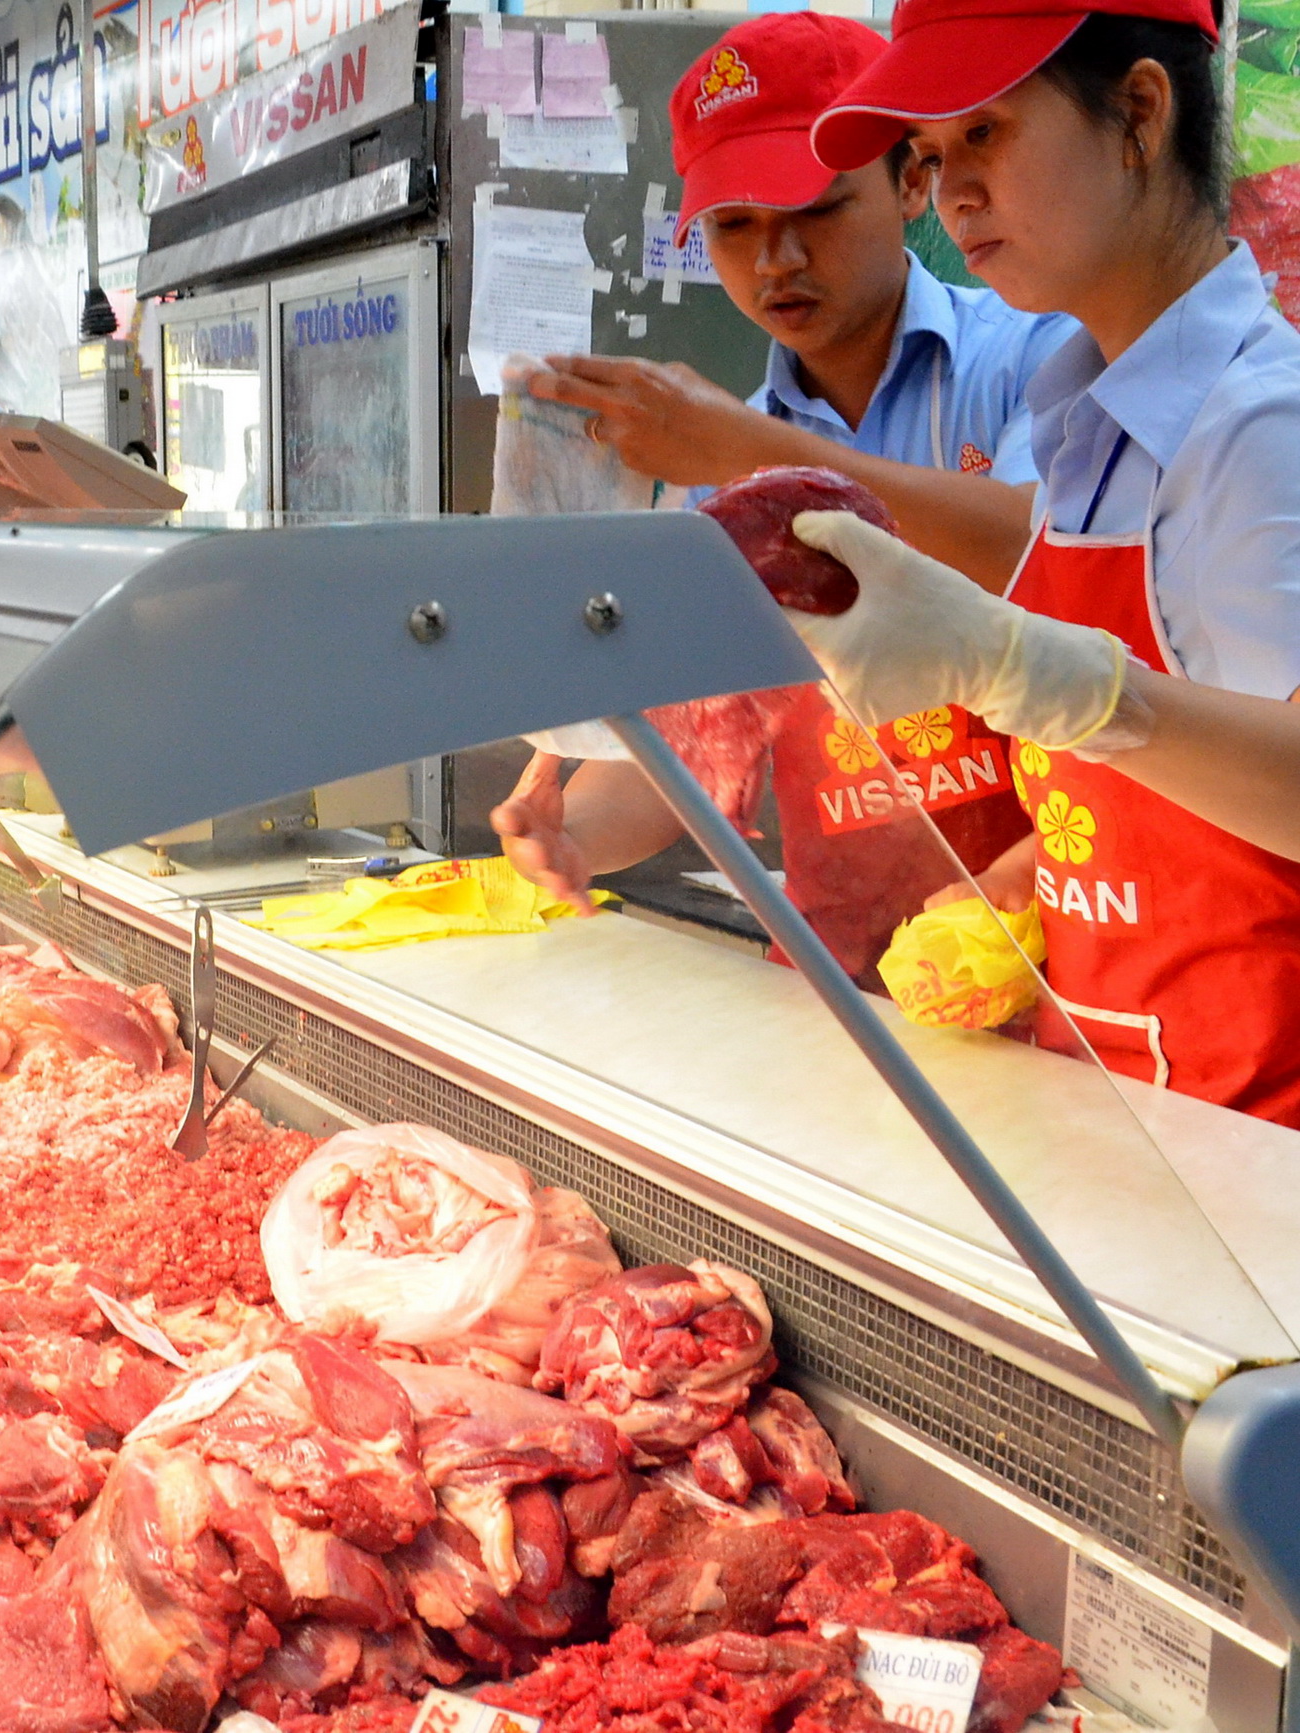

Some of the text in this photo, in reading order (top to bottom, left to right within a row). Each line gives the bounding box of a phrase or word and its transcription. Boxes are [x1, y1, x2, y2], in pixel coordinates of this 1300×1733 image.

[229, 45, 367, 157] VISSAN
[343, 275, 397, 340] SỐNG
[819, 750, 999, 824] VISSAN
[1036, 866, 1138, 924] SAN
[865, 1650, 970, 1687] NẠC ĐÙI BÒ
